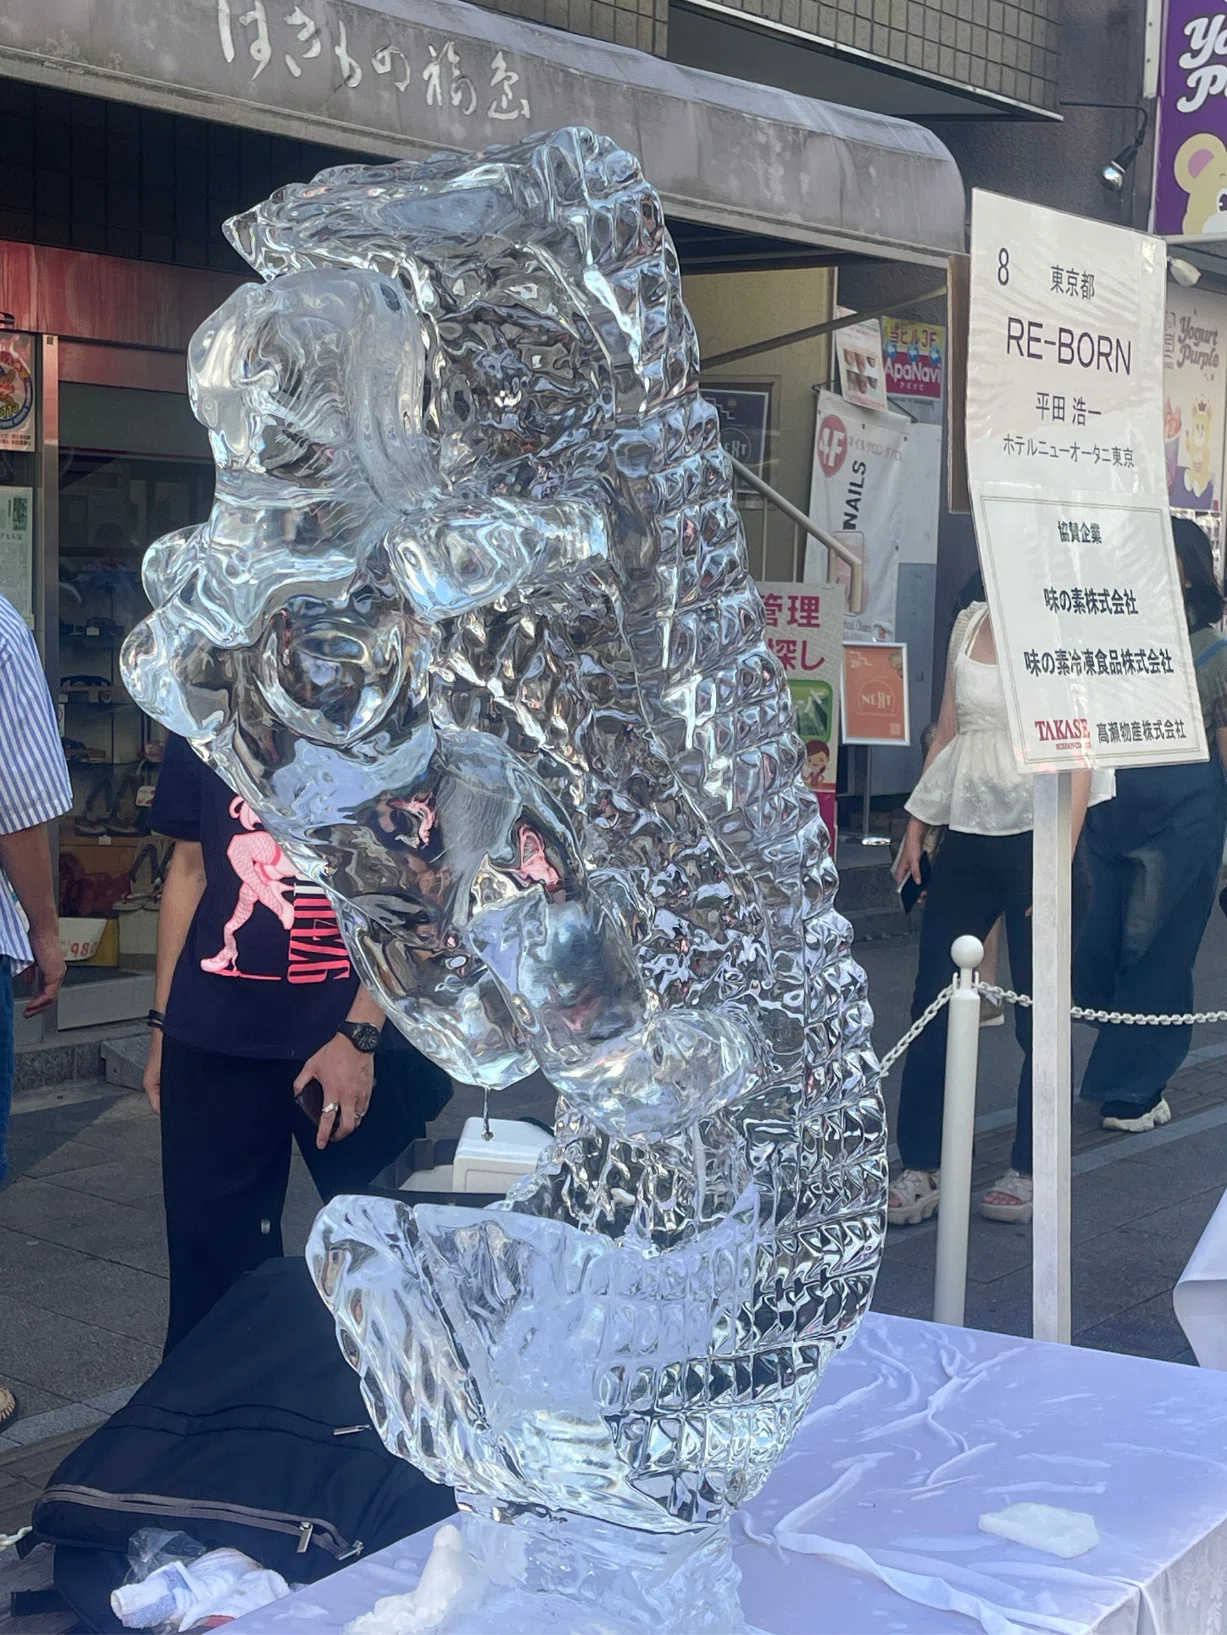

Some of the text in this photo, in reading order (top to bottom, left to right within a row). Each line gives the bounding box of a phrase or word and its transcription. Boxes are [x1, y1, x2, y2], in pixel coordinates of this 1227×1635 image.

[997, 247, 1010, 286] 8
[1050, 264, 1095, 300] 東京都
[1006, 316, 1132, 375] RE-BORN
[1178, 316, 1219, 347] Yogurt
[1177, 343, 1220, 370] Purple
[1036, 391, 1102, 426] 平田 浩一
[1003, 433, 1135, 468] ホテルニューオータニ東京
[842, 460, 867, 530] NAILS
[1057, 520, 1102, 544] 協賛企業
[1043, 586, 1139, 615] 味の素株式会社
[1023, 648, 1175, 677] 味の素冷凍食品株式会社
[1034, 718, 1091, 741] TAKASE
